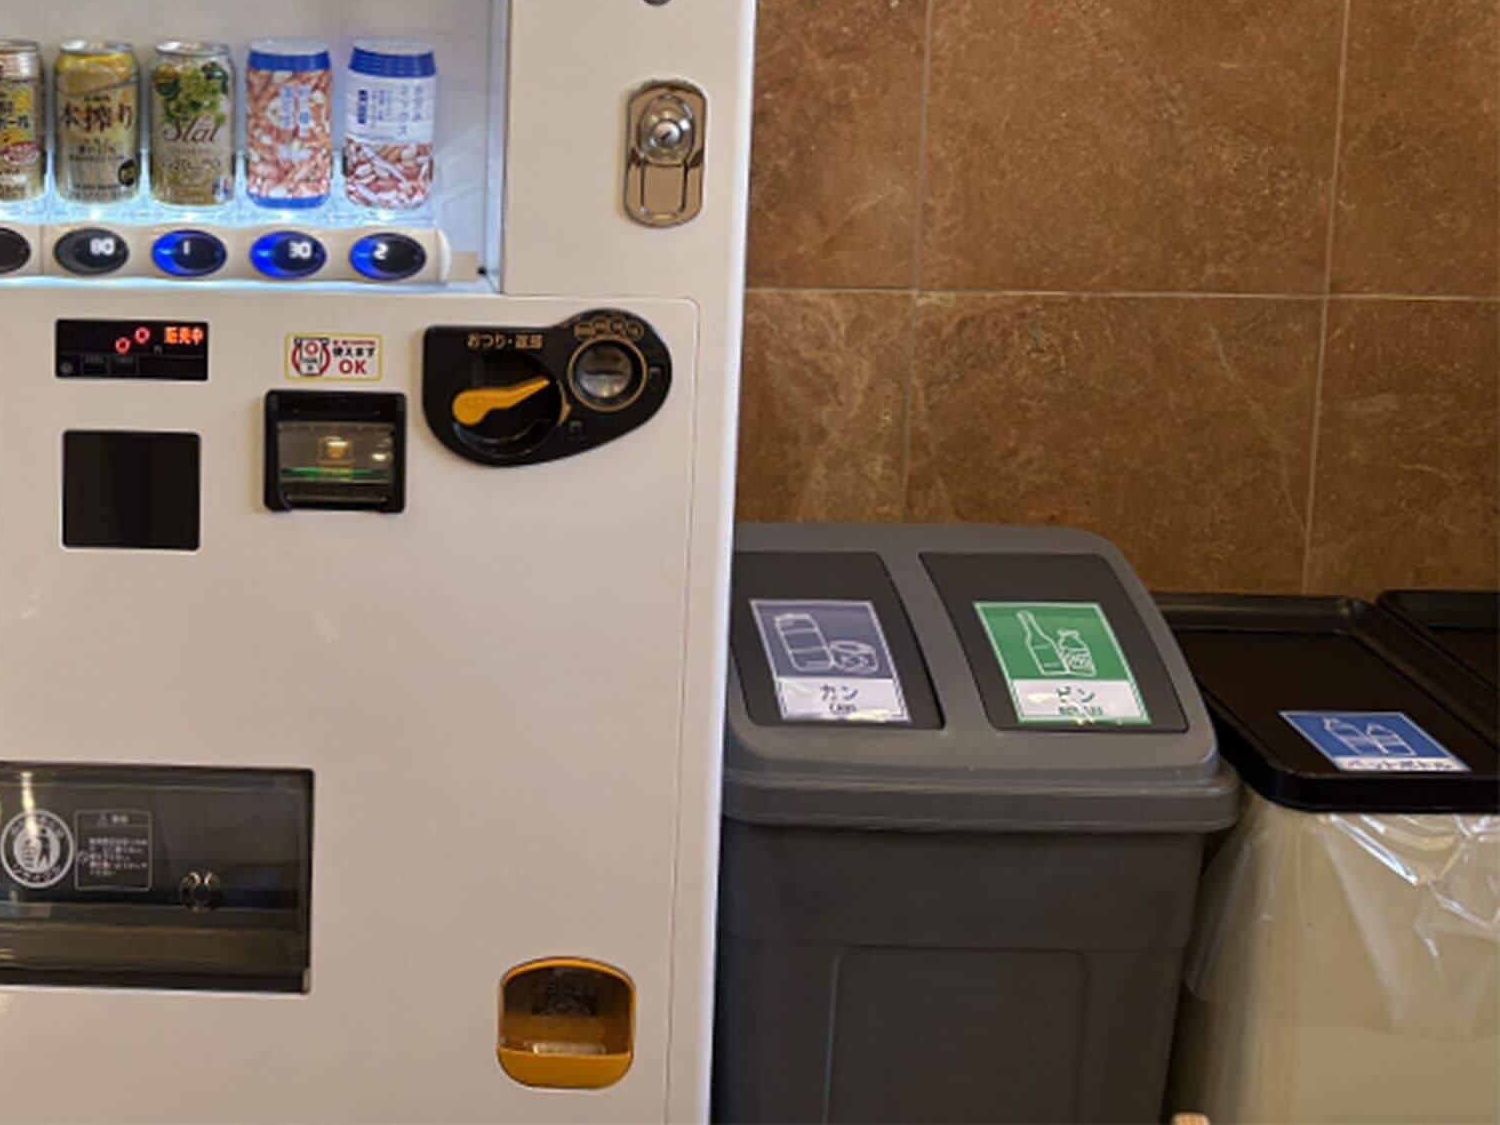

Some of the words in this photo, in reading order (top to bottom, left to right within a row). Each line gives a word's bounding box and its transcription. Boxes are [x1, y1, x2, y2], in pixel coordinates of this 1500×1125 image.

[60, 101, 133, 132] 本搾り
[339, 359, 367, 375] OK
[820, 685, 858, 701] カン
[1056, 686, 1096, 703] ビン
